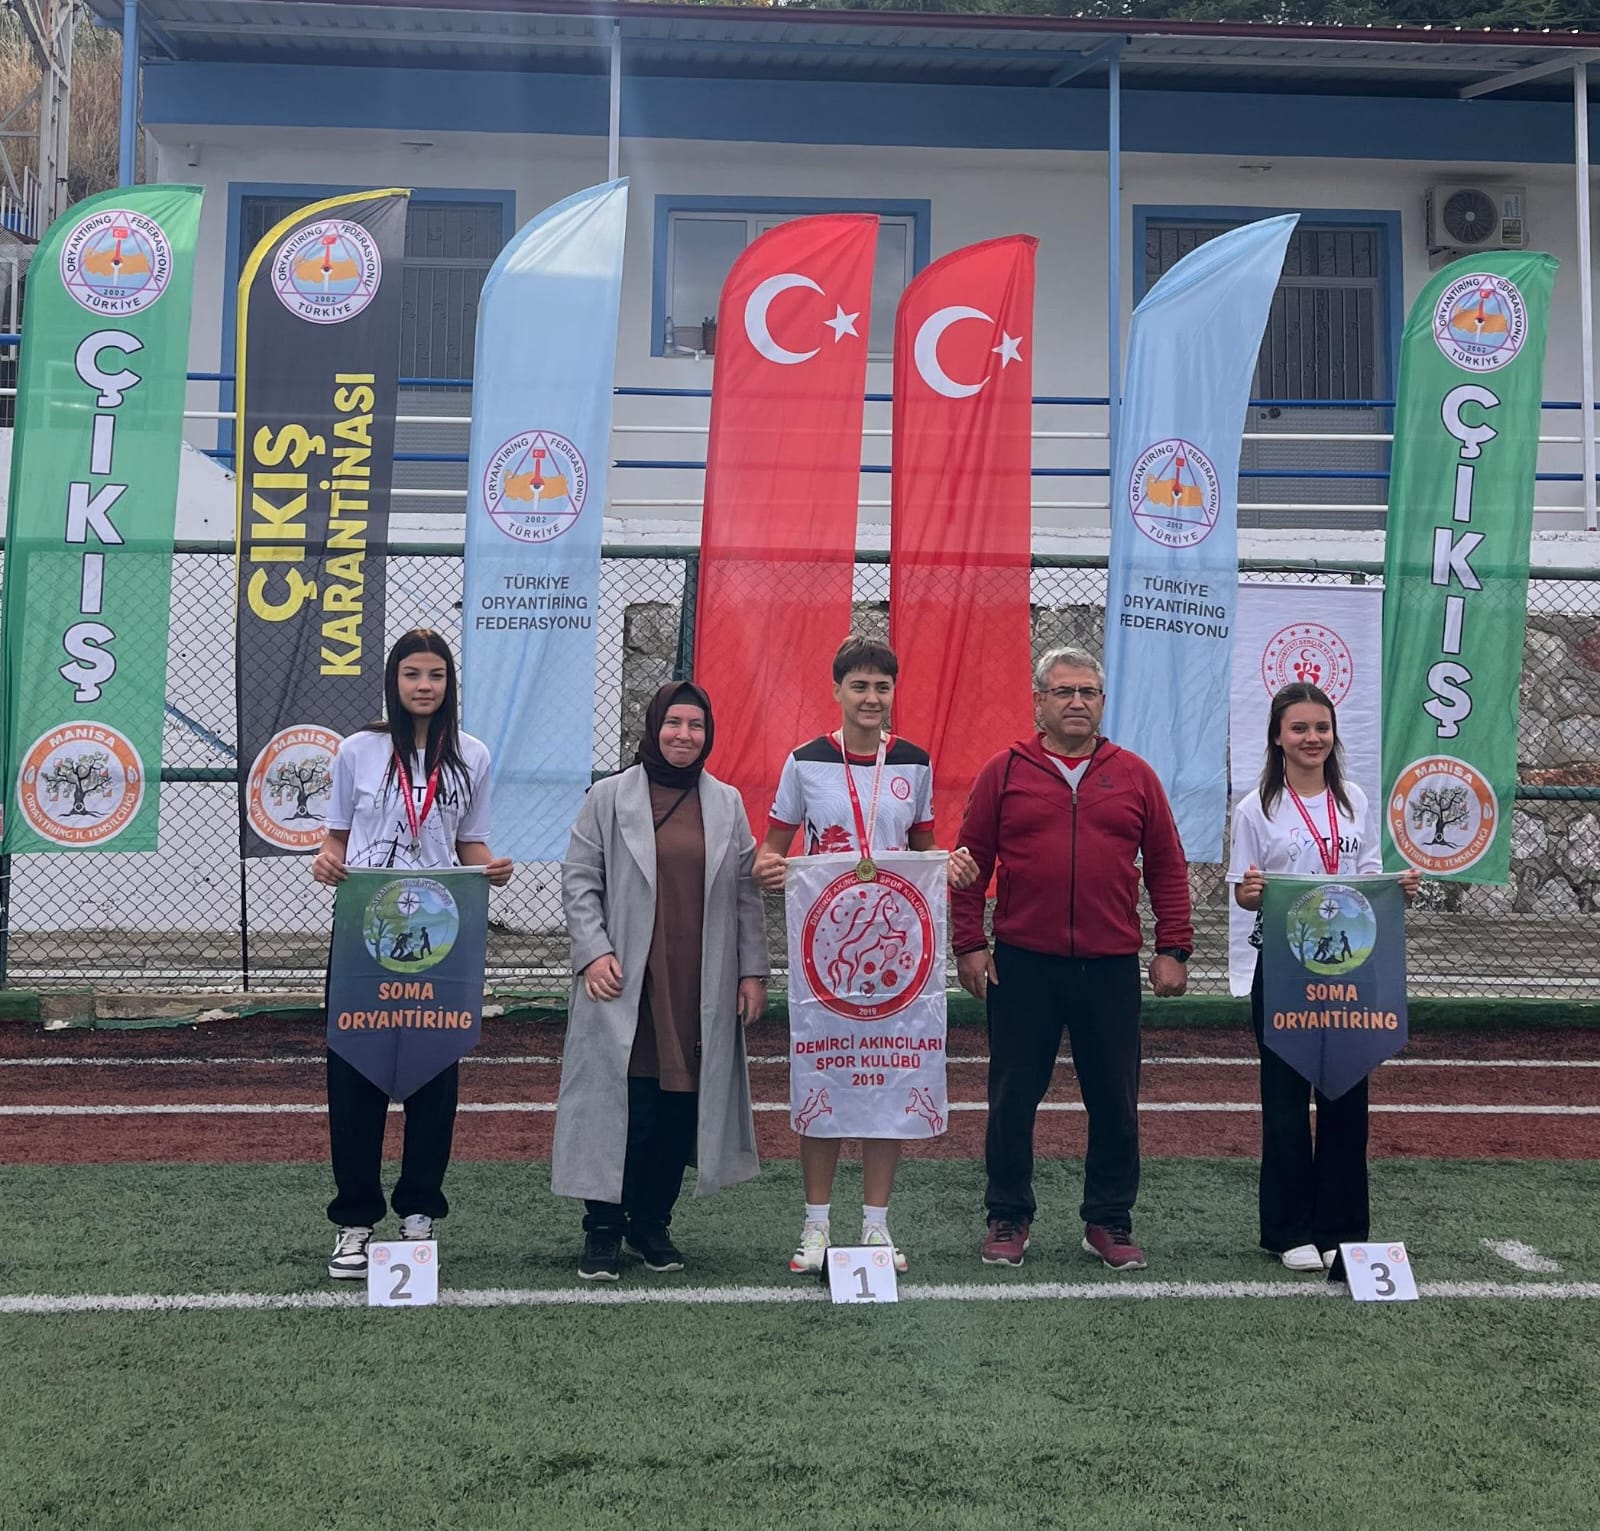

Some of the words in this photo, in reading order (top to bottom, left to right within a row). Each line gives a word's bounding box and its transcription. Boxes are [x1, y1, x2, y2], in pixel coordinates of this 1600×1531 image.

[67, 215, 112, 272] ORYANTİRİNG
[131, 216, 167, 282] FEDERASYONU
[278, 226, 323, 281] ORYANTİRİNG
[86, 294, 141, 310] TÜRKİYE
[298, 302, 351, 317] TÜRKİYE
[1439, 278, 1480, 326] ORYANTİRİNG
[1451, 348, 1499, 366] TÜRKİYE
[488, 438, 529, 500] ORYANTİRİNG
[550, 438, 584, 502] FEDERASYONU
[1132, 444, 1174, 502] ORYANTİRİNG
[1187, 448, 1217, 516] FEDERASYONU
[59, 329, 144, 703] ÇIKIŞ
[247, 423, 326, 622] ÇIKIŞ
[320, 373, 375, 677] KARANTİNASI
[525, 515, 547, 523] 2002
[508, 522, 560, 539] TÜRKİYE
[1149, 525, 1199, 544] TÜRKİYE
[1423, 383, 1501, 738] ÇIKIŞ
[504, 573, 570, 590] TÜRKİYE
[1143, 575, 1209, 597] TÜRKİYE
[481, 593, 588, 610] ORYANTİRİNG
[1124, 594, 1225, 619] ORYANTİRİNG
[475, 616, 591, 630] FEDERASYONU
[1120, 613, 1229, 639] FEDERASYONU
[49, 727, 115, 748] MANİSA
[272, 731, 337, 752] MANİSA
[1414, 762, 1473, 784] MANİSA
[880, 875, 903, 890] SPOR
[378, 981, 434, 1001] SOMA
[1306, 983, 1358, 1002] SOMA
[337, 1005, 473, 1030] ORYANTİRİNG
[858, 1007, 877, 1016] 2019
[1272, 1006, 1398, 1031] ORYANTİRİNG
[795, 1034, 854, 1054] DEMİRCİ
[859, 1036, 942, 1051] AKINCILARI
[816, 1055, 856, 1070] SPOR
[861, 1052, 921, 1068] KULÜBÜ
[852, 1074, 885, 1086] 2019
[389, 1263, 412, 1300] 2
[853, 1266, 876, 1298] 1
[1370, 1262, 1396, 1296] 3
